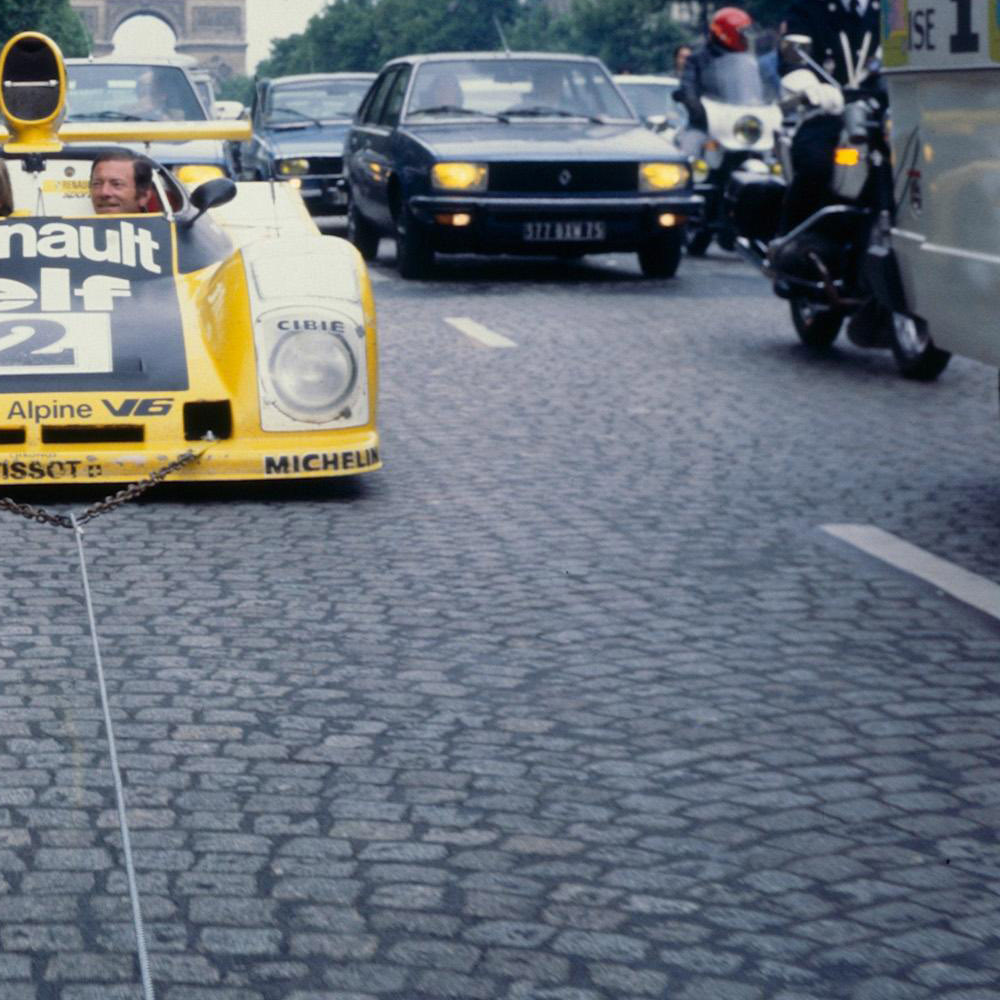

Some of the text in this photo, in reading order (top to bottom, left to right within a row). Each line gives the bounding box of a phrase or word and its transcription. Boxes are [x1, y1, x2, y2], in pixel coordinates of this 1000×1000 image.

[277, 319, 345, 333] CIBIE
[7, 400, 94, 424] Alpine
[101, 398, 175, 417] V6
[264, 447, 380, 475] MICHELIN
